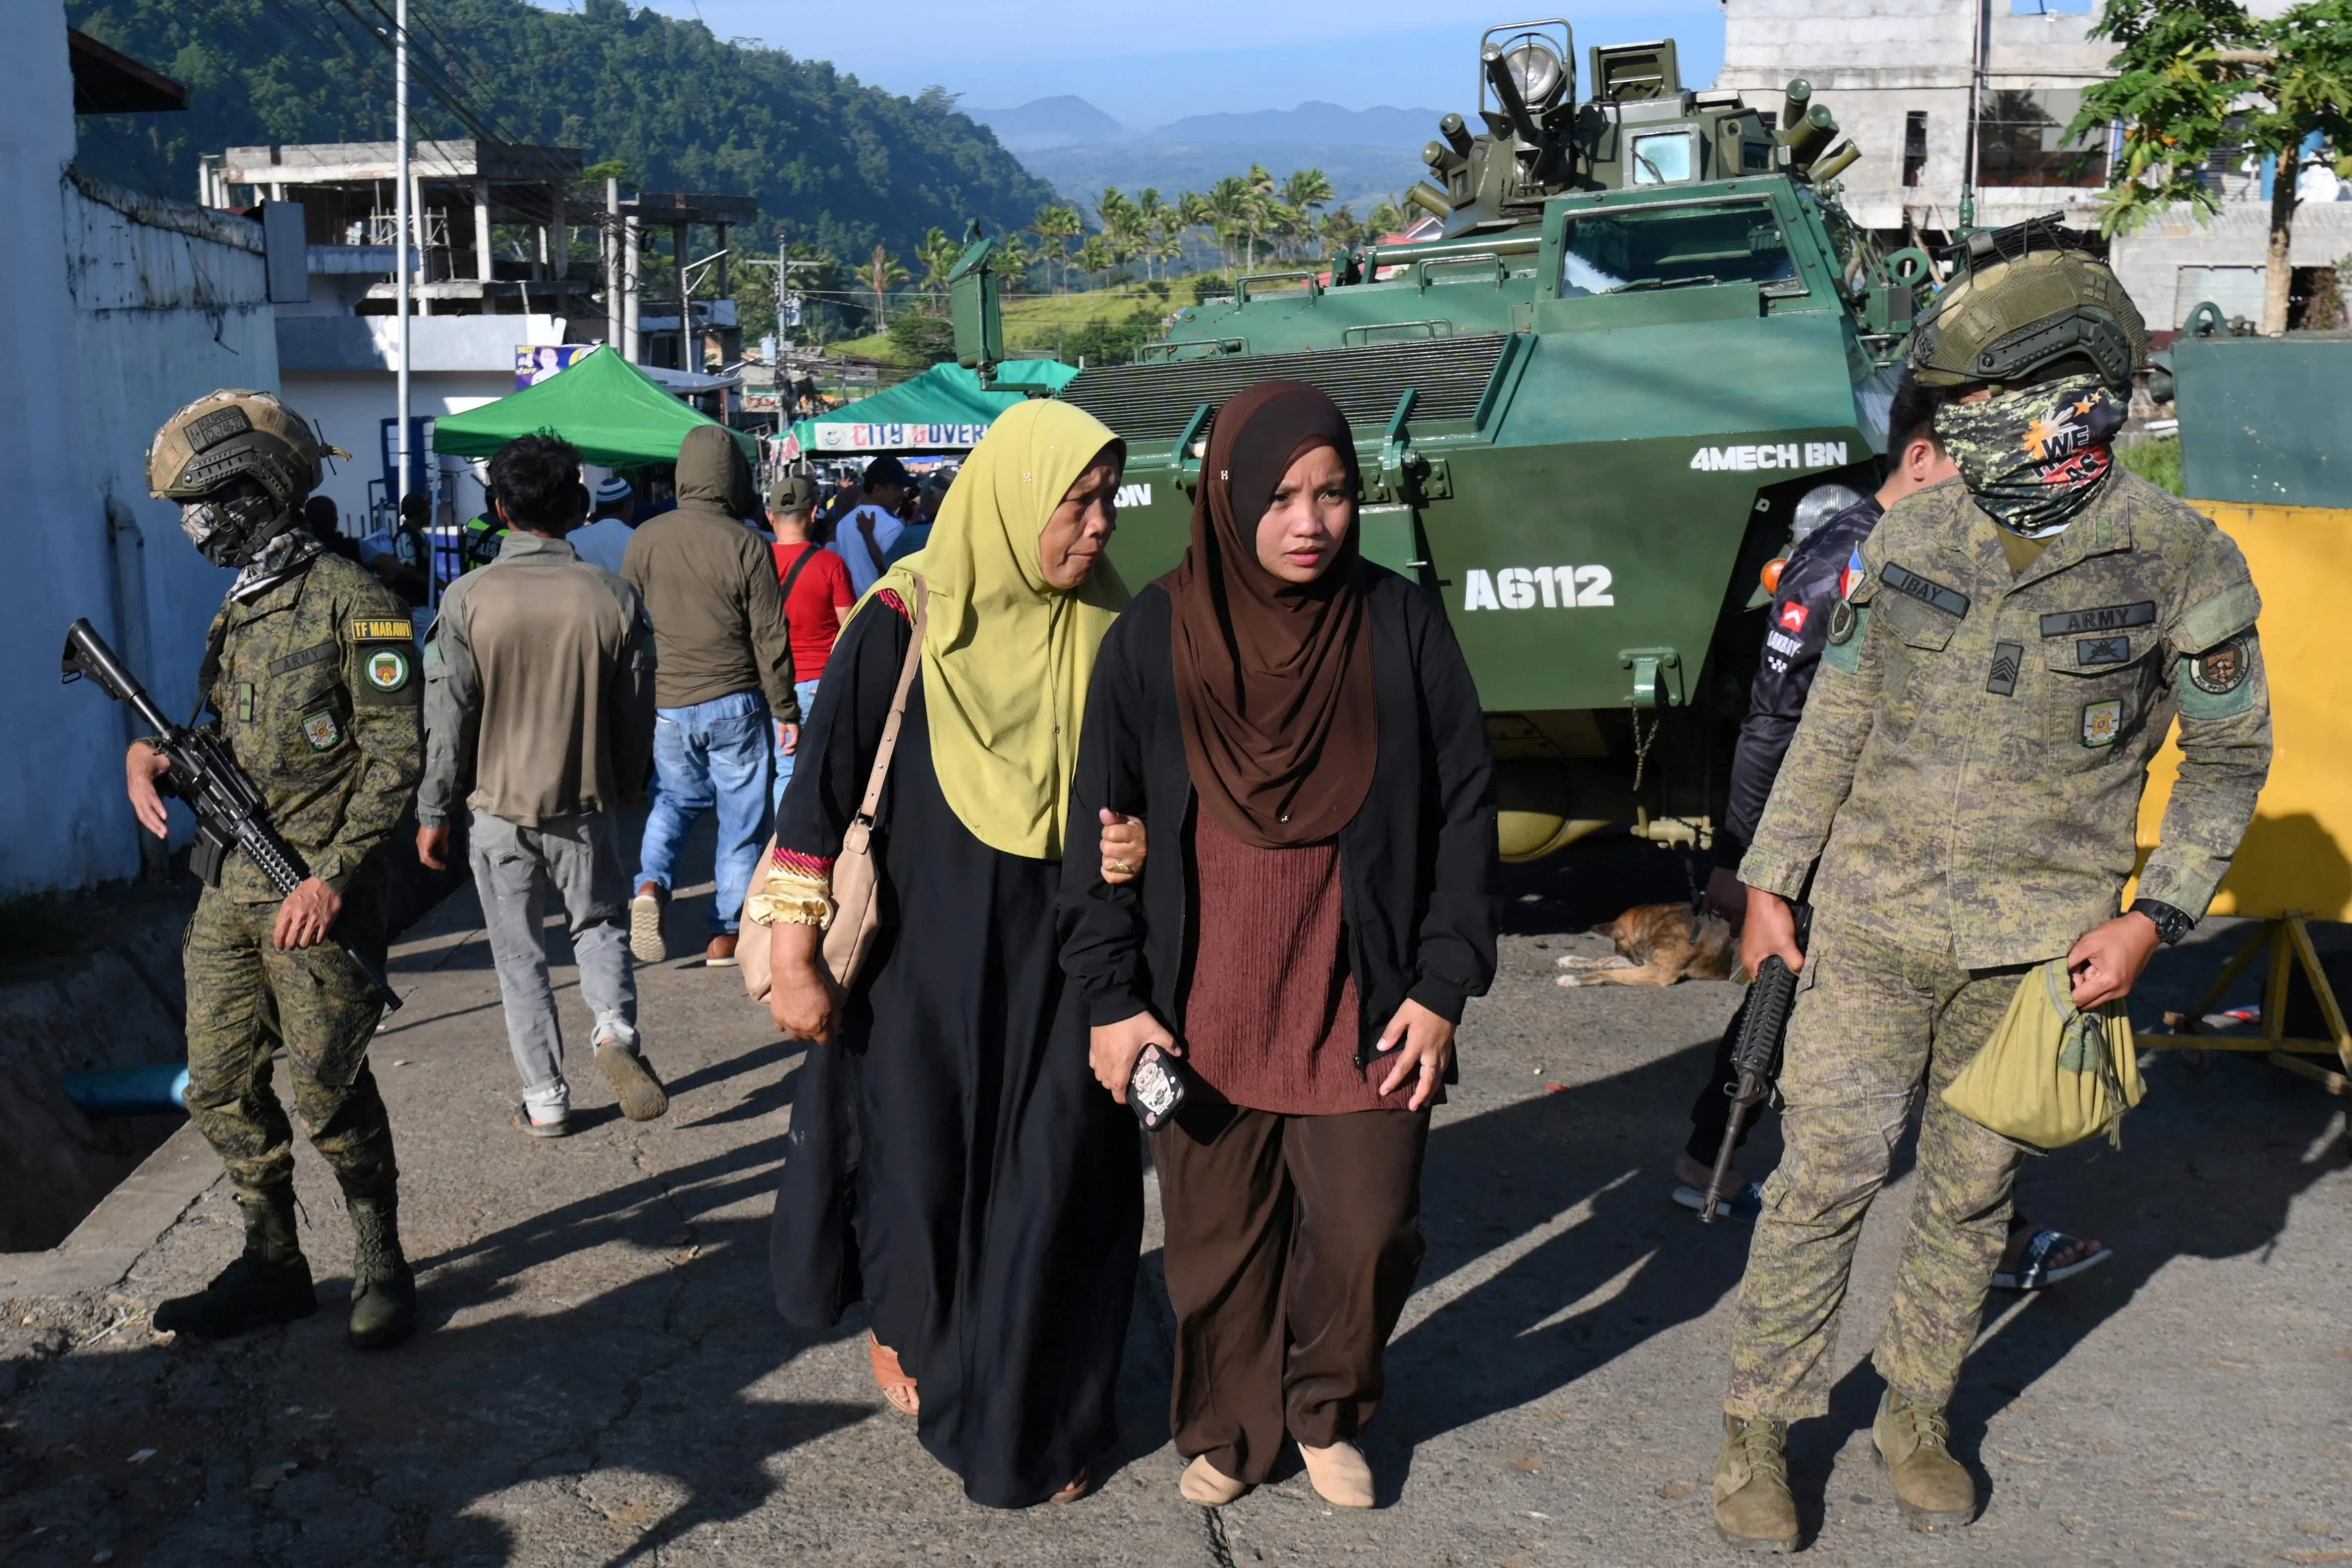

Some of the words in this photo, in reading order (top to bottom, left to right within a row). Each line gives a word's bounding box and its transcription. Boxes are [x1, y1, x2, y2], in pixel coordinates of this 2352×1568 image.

[206, 416, 245, 442] CL-746-22
[853, 424, 903, 446] CITY
[912, 424, 989, 444] GOVER
[2041, 425, 2089, 459] WE
[1690, 443, 1800, 471] 4MECH
[1805, 441, 1847, 467] BN
[1464, 564, 1615, 611] A6112
[1900, 574, 1943, 601] IBAY
[354, 621, 368, 637] TF
[369, 621, 410, 637] MARAWI
[2067, 607, 2130, 630] ARMY
[284, 649, 319, 669] ARMY
